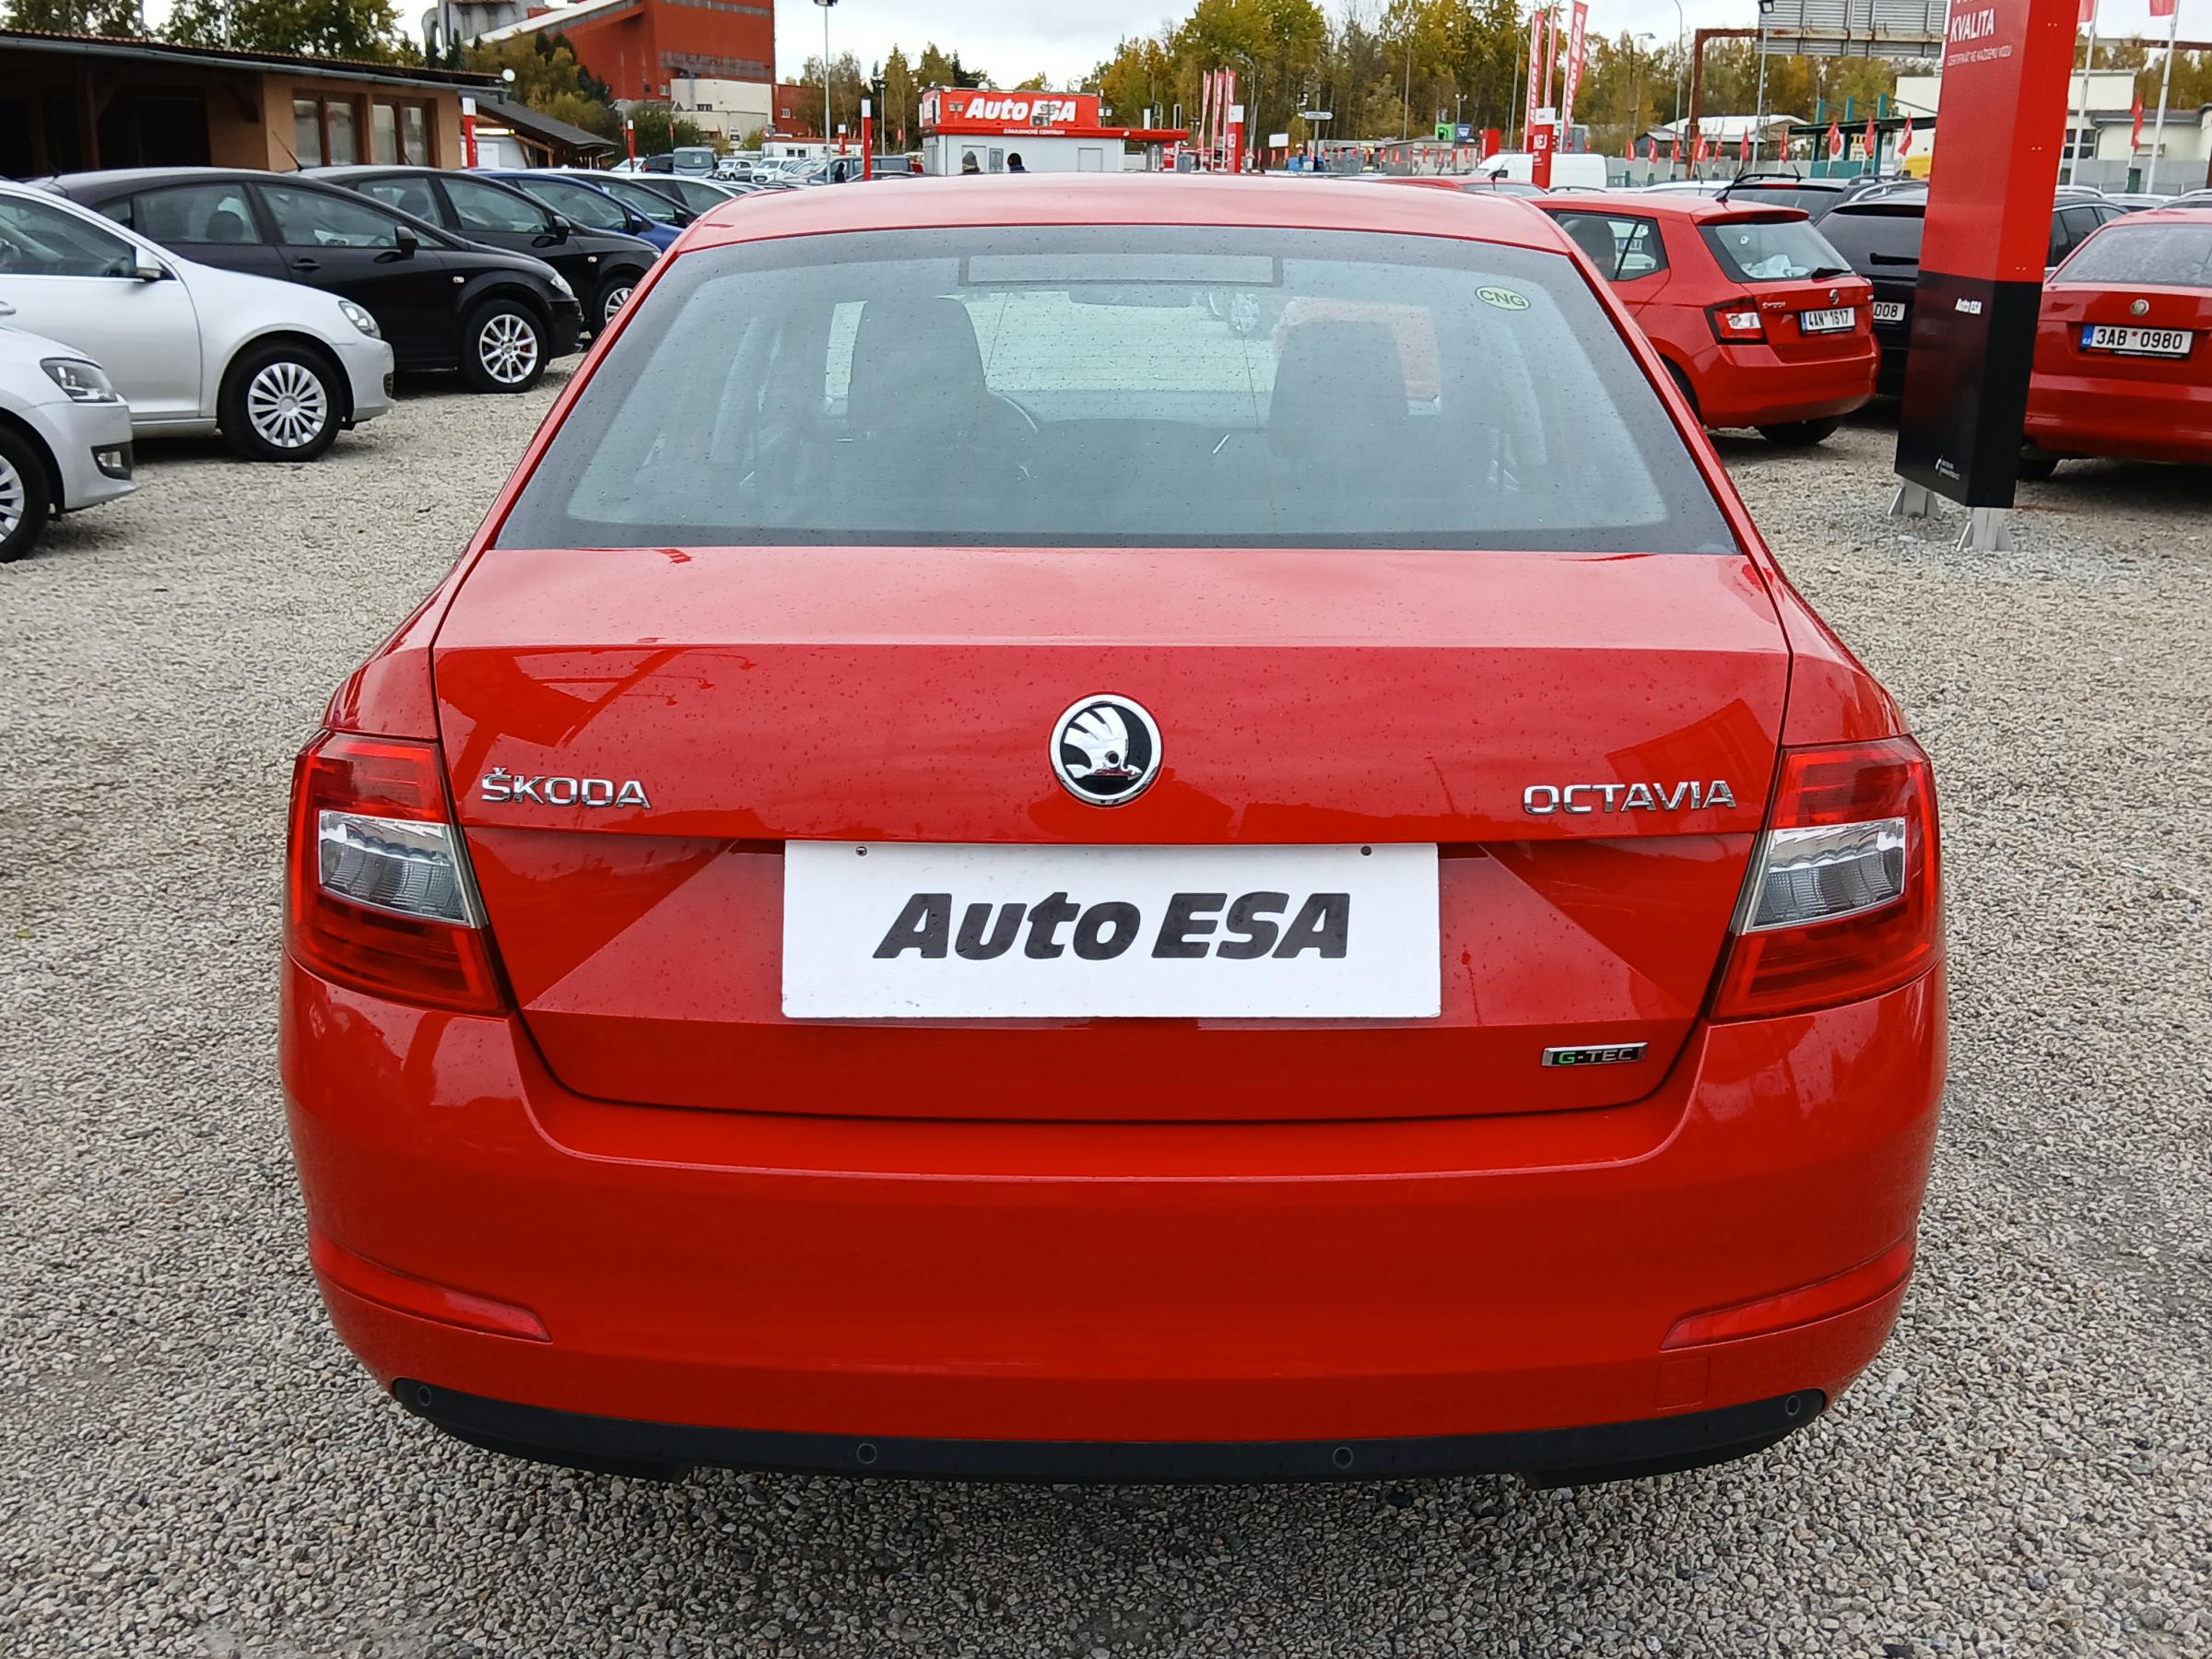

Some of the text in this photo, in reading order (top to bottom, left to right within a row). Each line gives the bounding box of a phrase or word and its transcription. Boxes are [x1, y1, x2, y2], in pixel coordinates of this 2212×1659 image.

[1949, 8, 1994, 42] KVALITA
[964, 97, 1029, 120] Auto
[1479, 289, 1526, 307] CNG
[1875, 303, 1899, 318] 008
[2096, 329, 2183, 349] 3AB 0980
[481, 767, 651, 809] ŠKODA
[1523, 780, 1737, 815] OCTAVIA
[872, 891, 1350, 960] Auto ESA
[1558, 1048, 1634, 1065] G-TEC
